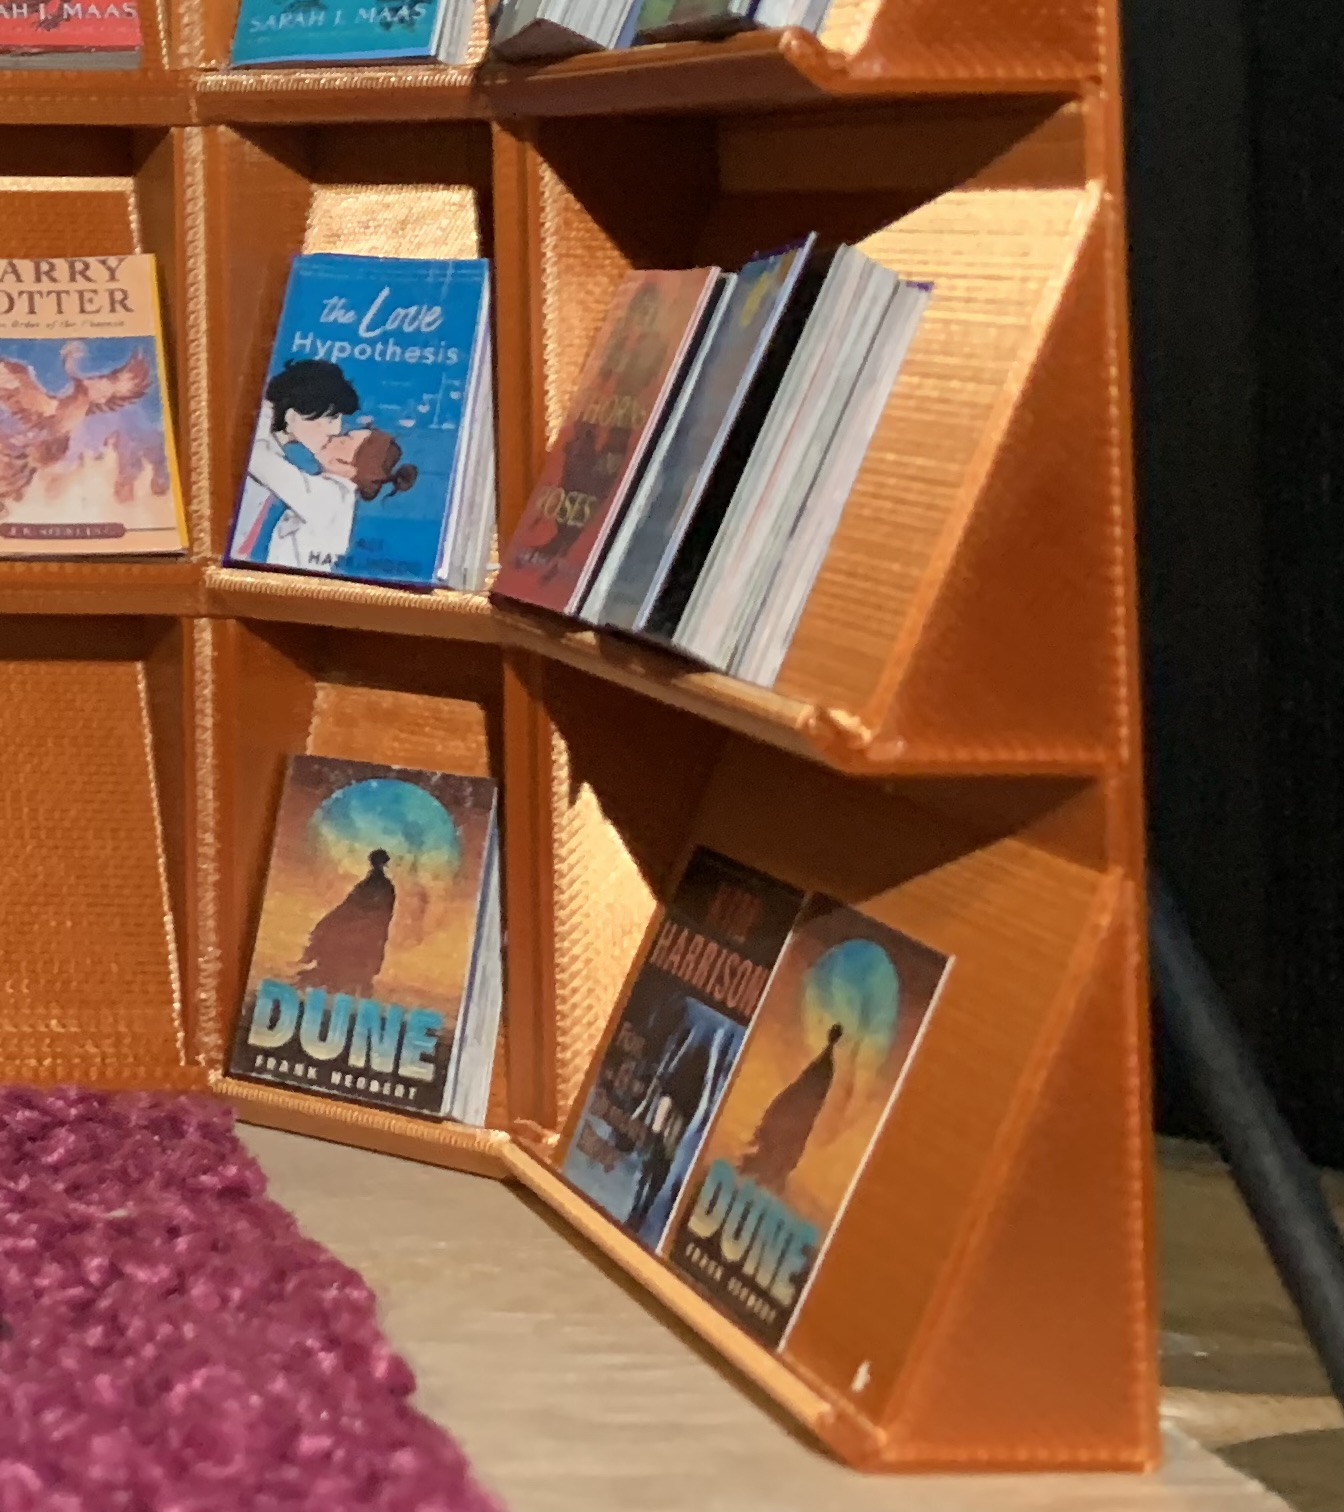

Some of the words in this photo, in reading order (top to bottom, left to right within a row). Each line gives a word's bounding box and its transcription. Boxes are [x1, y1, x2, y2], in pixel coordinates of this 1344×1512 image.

[62, 1, 138, 19] MAAS
[249, 9, 325, 33] SARAH
[355, 3, 427, 23] MAAS
[358, 286, 443, 338] Love
[292, 331, 459, 365] Hypothesis
[650, 922, 770, 1018] HARRISON
[247, 978, 444, 1082] DUNE
[254, 1055, 318, 1080] FRANK
[330, 1069, 418, 1100] HERBERT
[686, 1158, 821, 1309] DUNE
